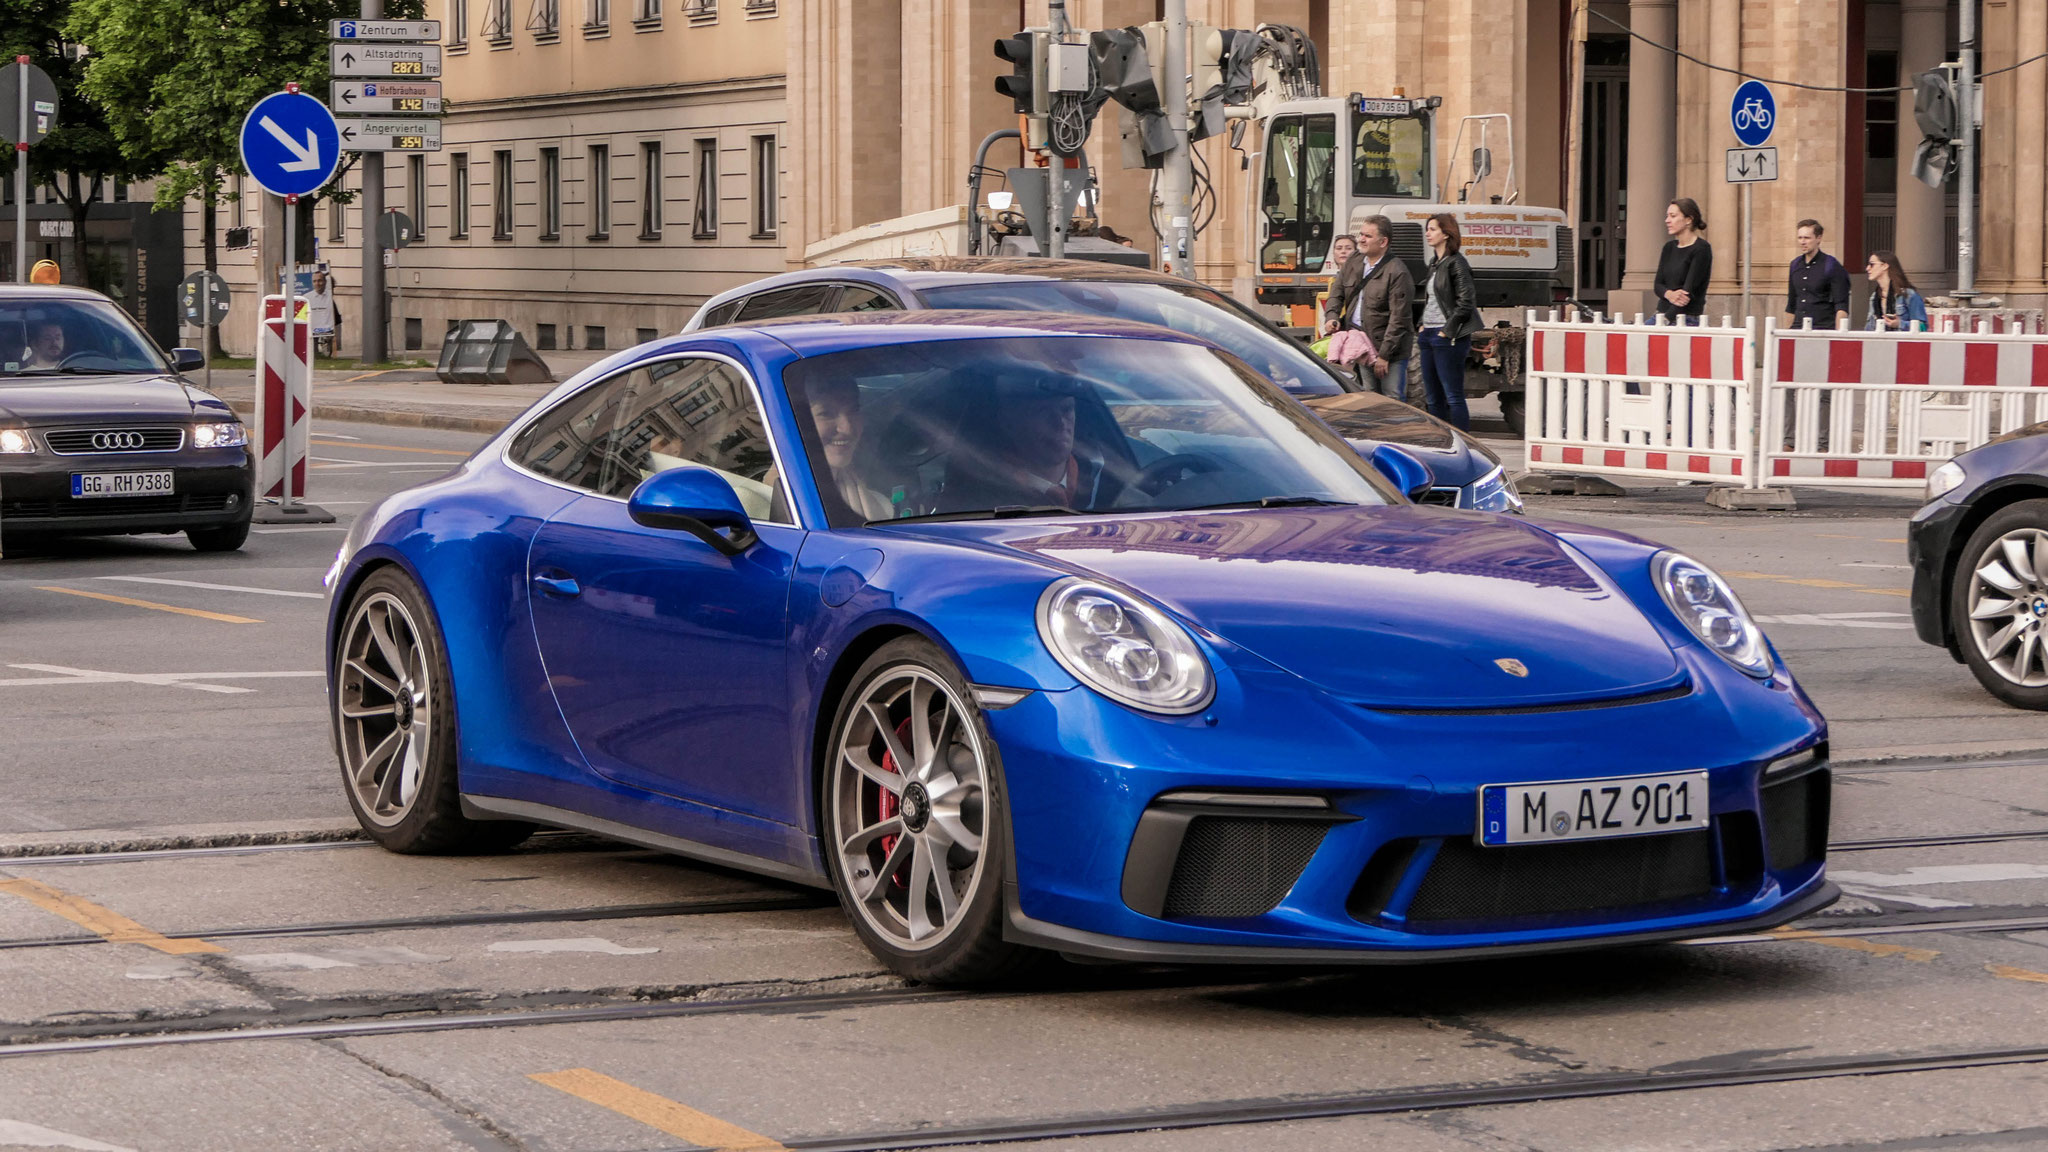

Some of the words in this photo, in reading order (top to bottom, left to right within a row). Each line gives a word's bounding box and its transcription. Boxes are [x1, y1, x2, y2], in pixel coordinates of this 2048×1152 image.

[361, 24, 408, 35] Zentrum
[364, 49, 424, 61] Altstadtring
[392, 62, 421, 74] 2878
[426, 64, 439, 73] frei
[380, 86, 427, 95] Hofbräuhaus
[400, 99, 422, 110] 142
[426, 101, 440, 110] frei
[364, 123, 428, 135] Angerviertel
[400, 136, 422, 148] 354
[426, 138, 440, 147] frei
[60, 220, 75, 237] CARP
[137, 248, 147, 292] CARPET
[138, 296, 147, 329] BJECT
[83, 476, 102, 492] GG
[114, 475, 133, 492] RH
[136, 474, 171, 491] 9388
[1522, 791, 1547, 834] M
[1575, 786, 1622, 831] AZ
[1631, 780, 1692, 827] 901
